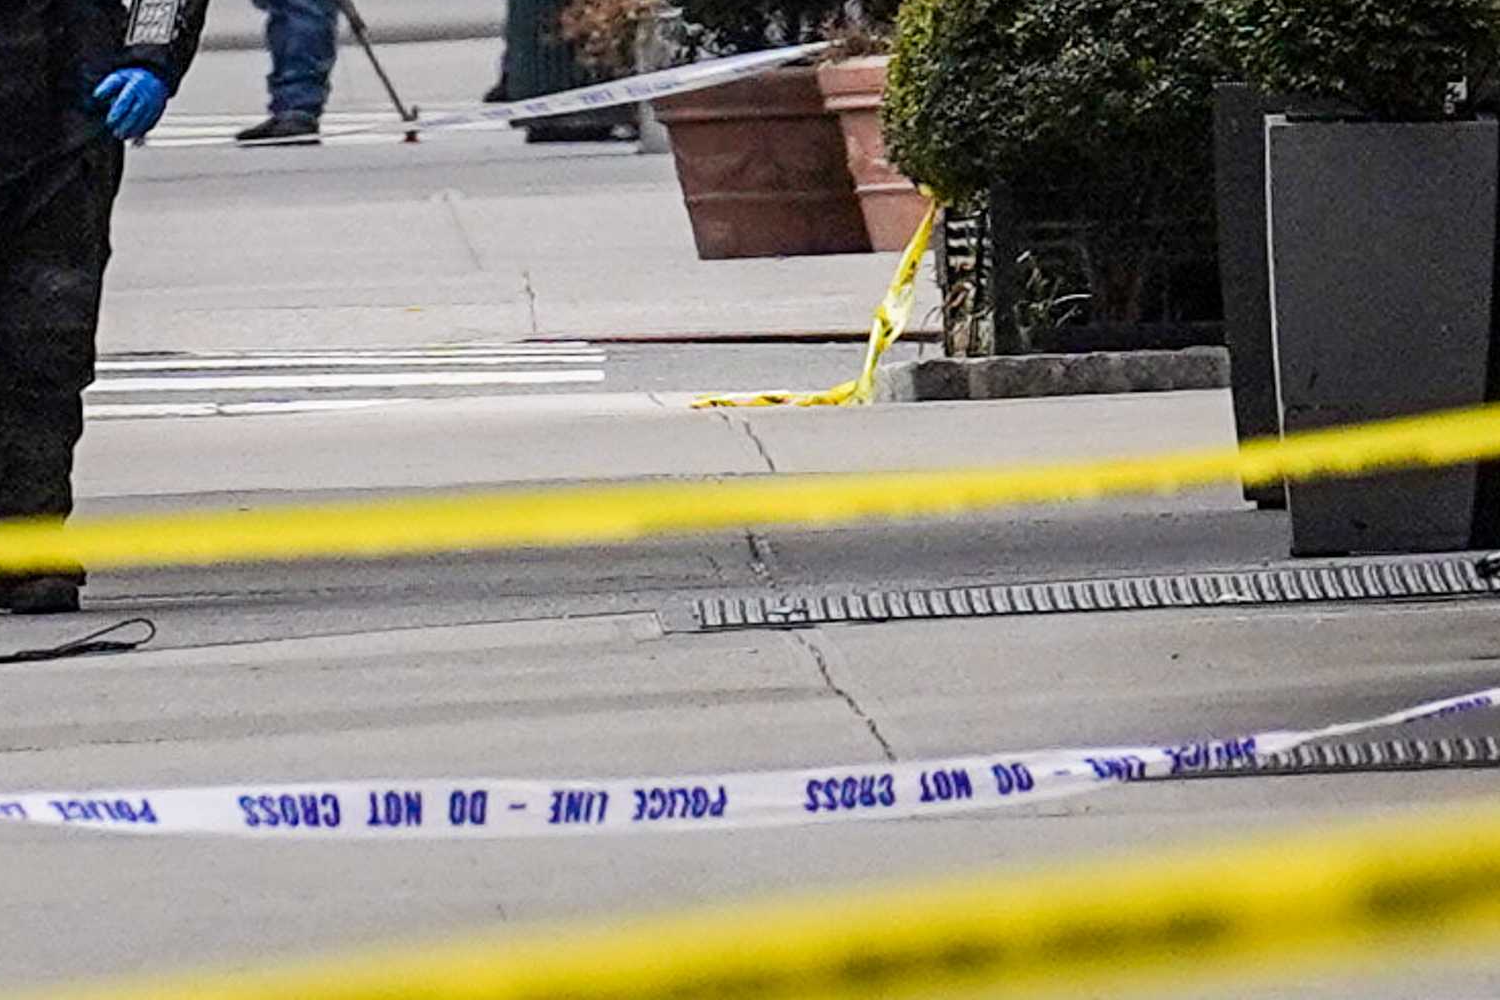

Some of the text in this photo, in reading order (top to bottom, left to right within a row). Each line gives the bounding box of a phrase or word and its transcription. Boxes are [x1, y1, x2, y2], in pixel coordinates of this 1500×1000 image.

[803, 772, 897, 815] CROSS
[916, 768, 974, 804] NOT
[989, 762, 1035, 798] DO
[234, 792, 343, 831] CROSS
[364, 791, 425, 830] NOT
[445, 790, 489, 827] DO
[546, 790, 610, 826] LINE
[631, 784, 731, 824] POLICE
